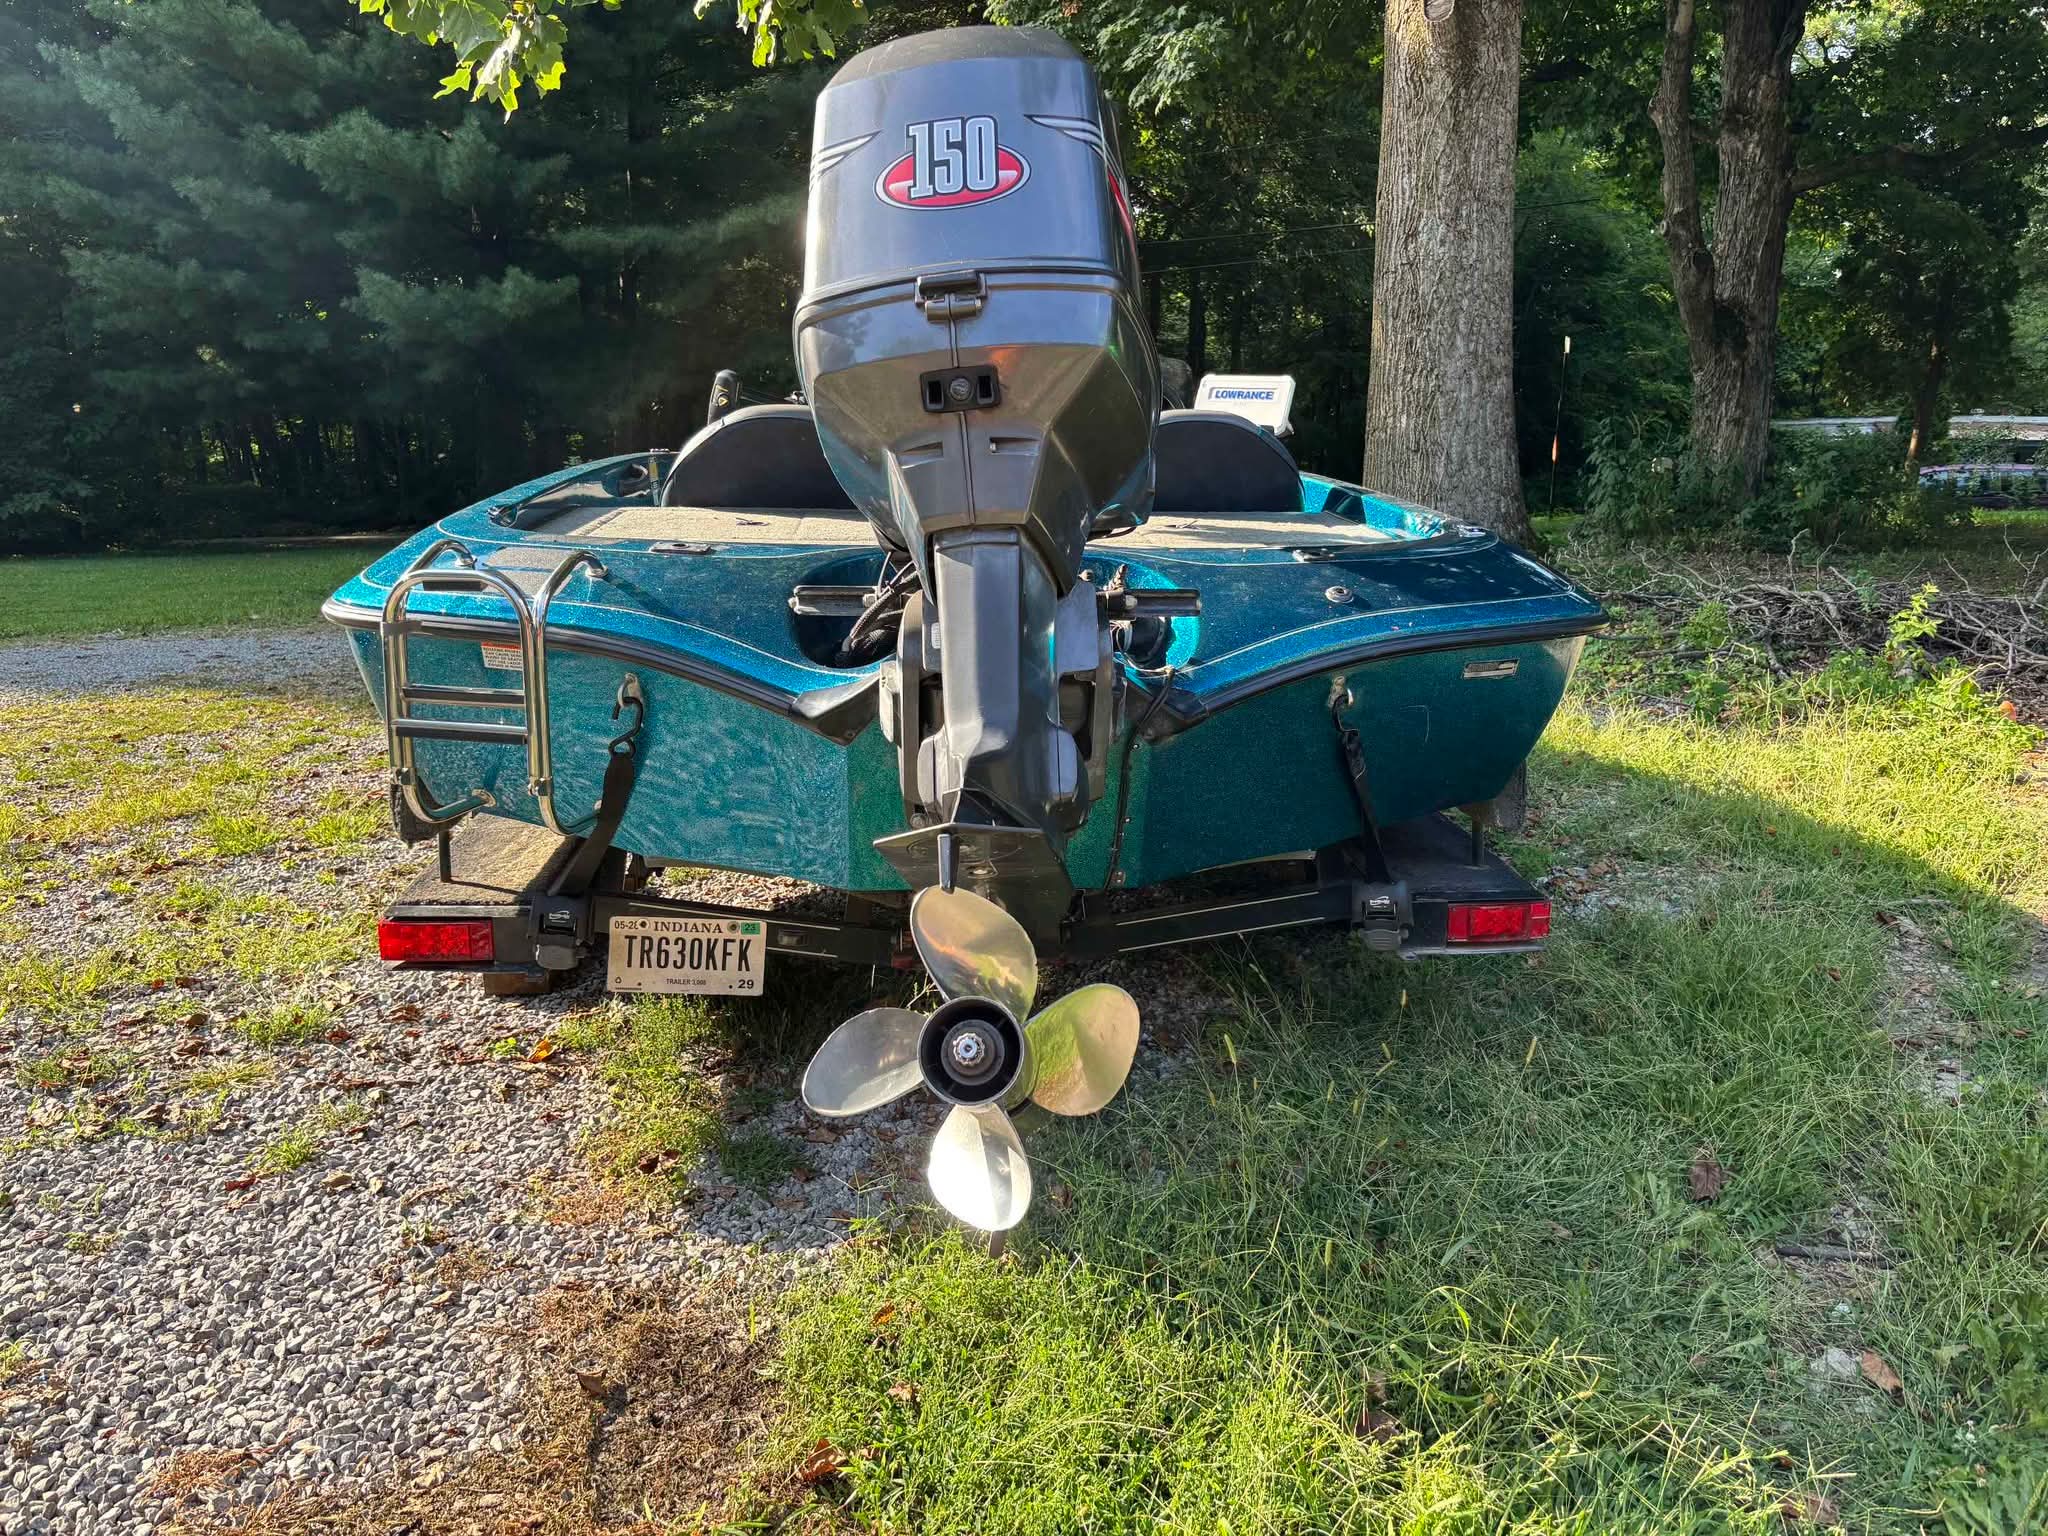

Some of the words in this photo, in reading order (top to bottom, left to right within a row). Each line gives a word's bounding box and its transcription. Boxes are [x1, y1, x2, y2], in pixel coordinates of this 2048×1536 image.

[907, 115, 998, 199] 150
[1214, 390, 1275, 400] LOWRANCE
[653, 920, 723, 934] INDIANA
[624, 935, 752, 972] TR630KFK
[738, 979, 754, 990] 29
